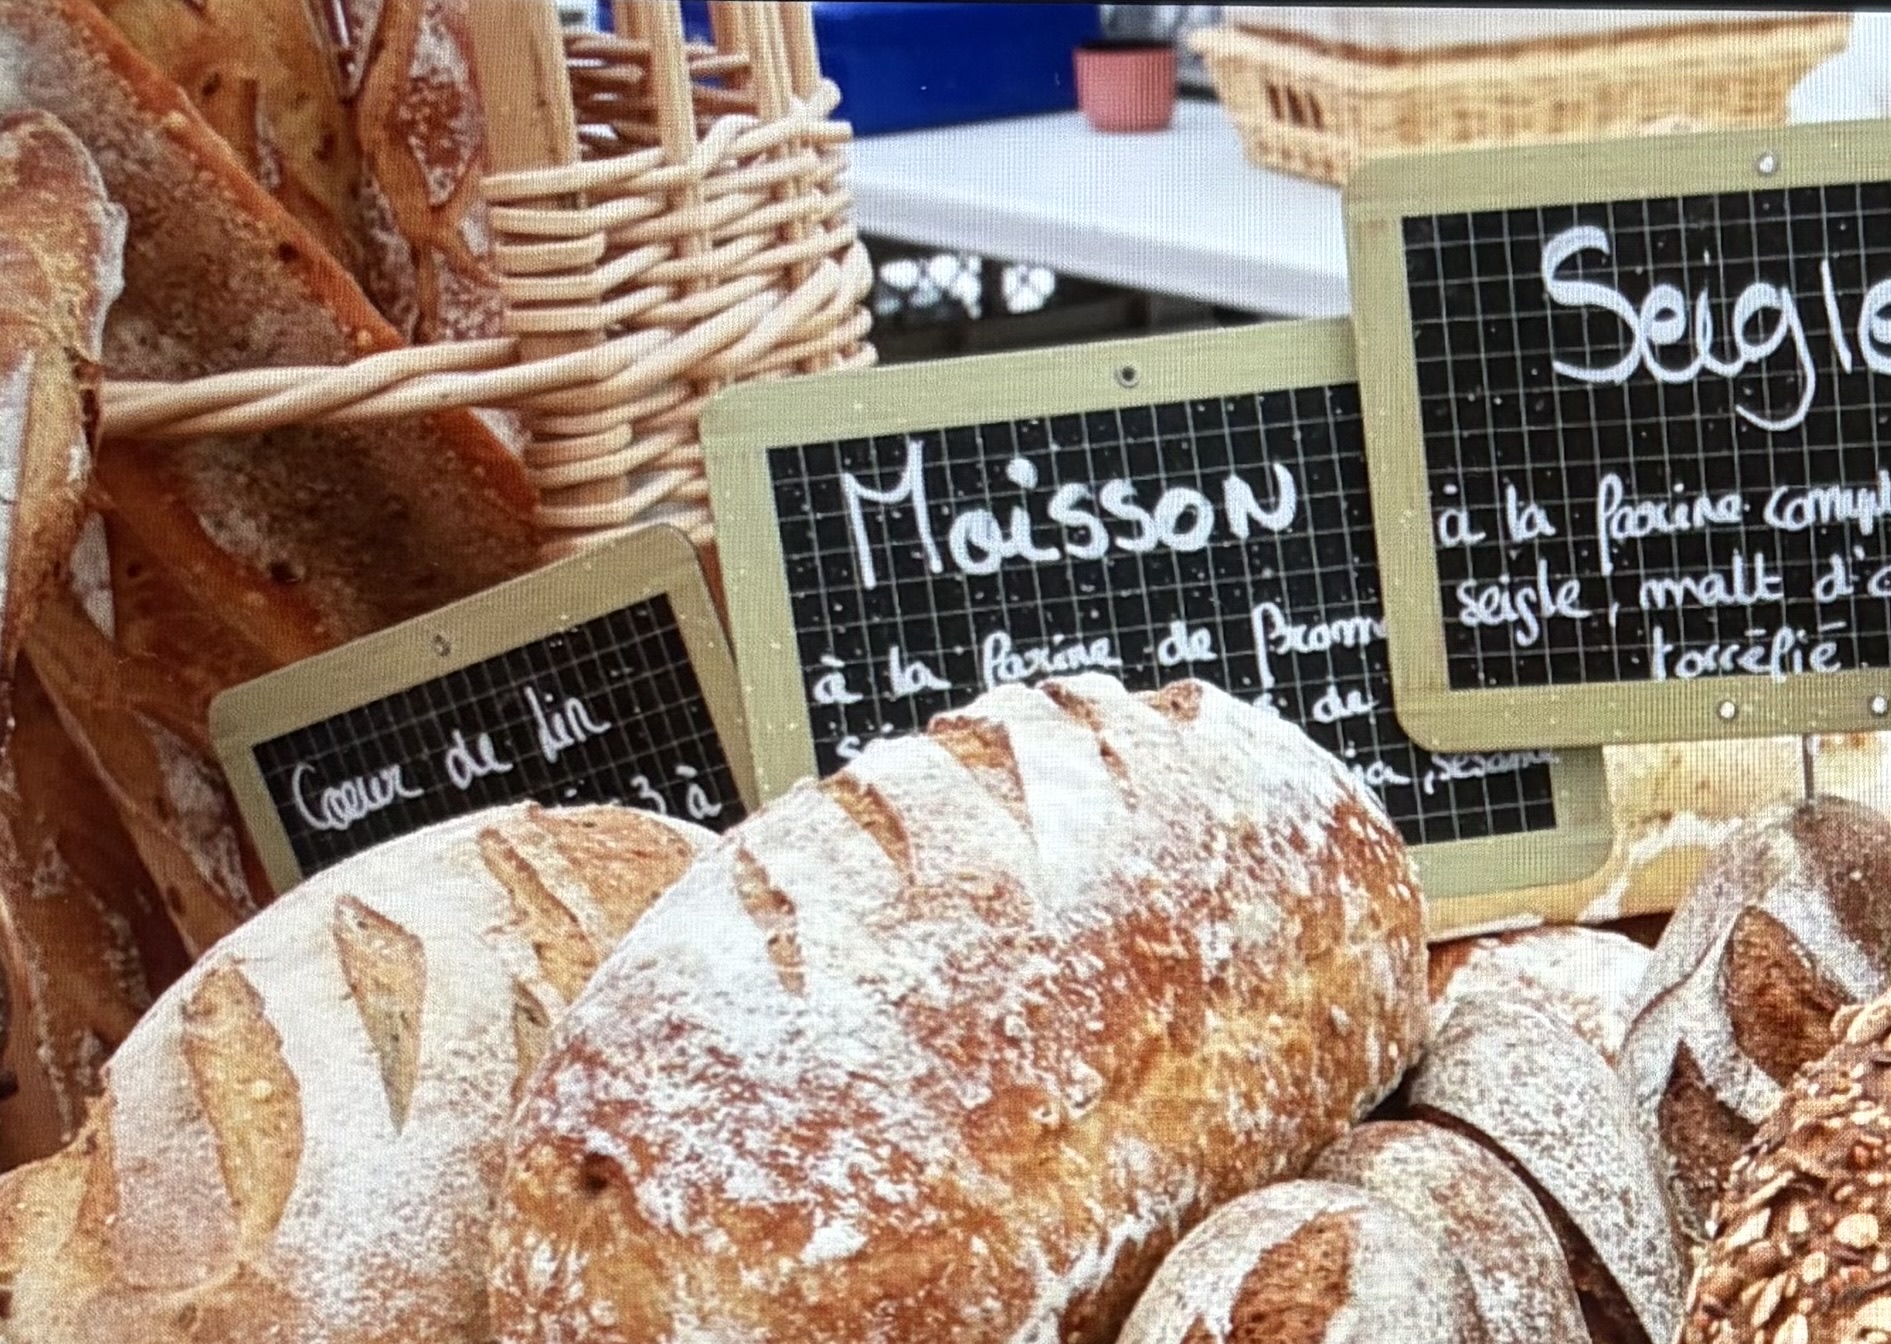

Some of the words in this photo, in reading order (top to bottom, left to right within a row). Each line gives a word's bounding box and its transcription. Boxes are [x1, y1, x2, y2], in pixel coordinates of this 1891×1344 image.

[1439, 484, 1486, 547] à
[1506, 483, 1557, 543] la
[1598, 472, 1742, 576] farine
[1640, 549, 1785, 611] malt
[813, 654, 864, 704] à
[889, 645, 952, 696] la
[1157, 620, 1218, 667] de
[446, 729, 514, 790] de
